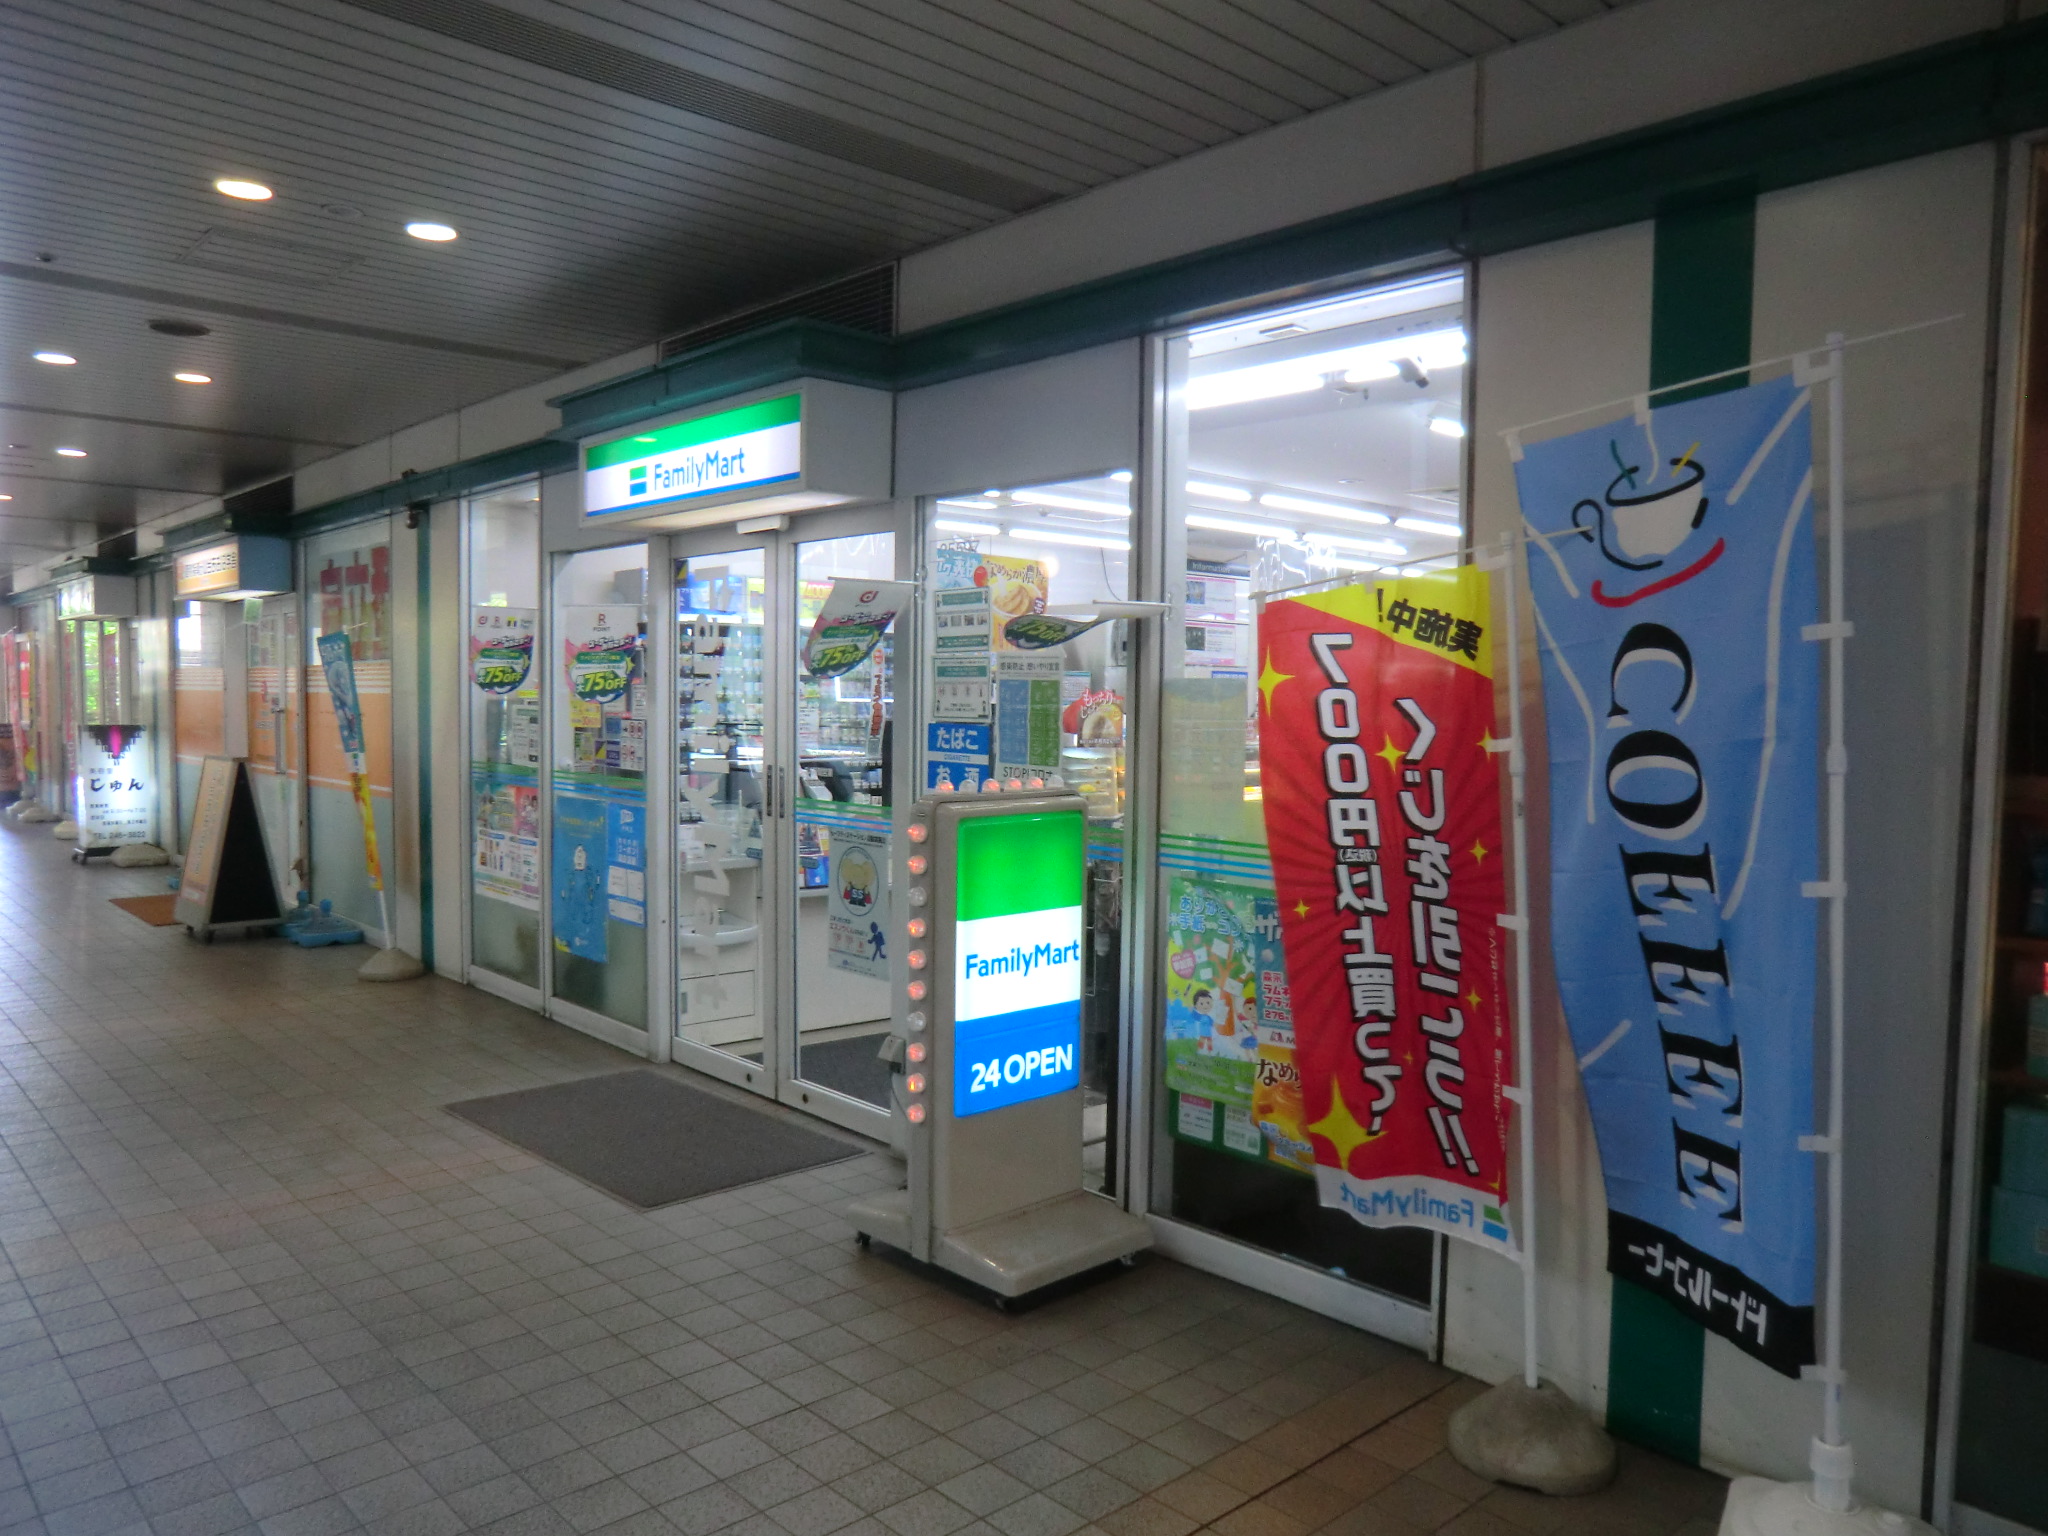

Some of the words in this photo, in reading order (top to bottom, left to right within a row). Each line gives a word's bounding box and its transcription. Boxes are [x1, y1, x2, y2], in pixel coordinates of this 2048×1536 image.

[654, 447, 745, 490] FamilyMart
[1192, 561, 1231, 574] Information
[936, 726, 979, 750] たばこ
[90, 777, 145, 793] じゅん
[684, 564, 733, 1014] FamilyMart
[965, 939, 1080, 979] FamilyMart
[970, 1062, 1002, 1093] 24
[1003, 1044, 1073, 1082] OPEN
